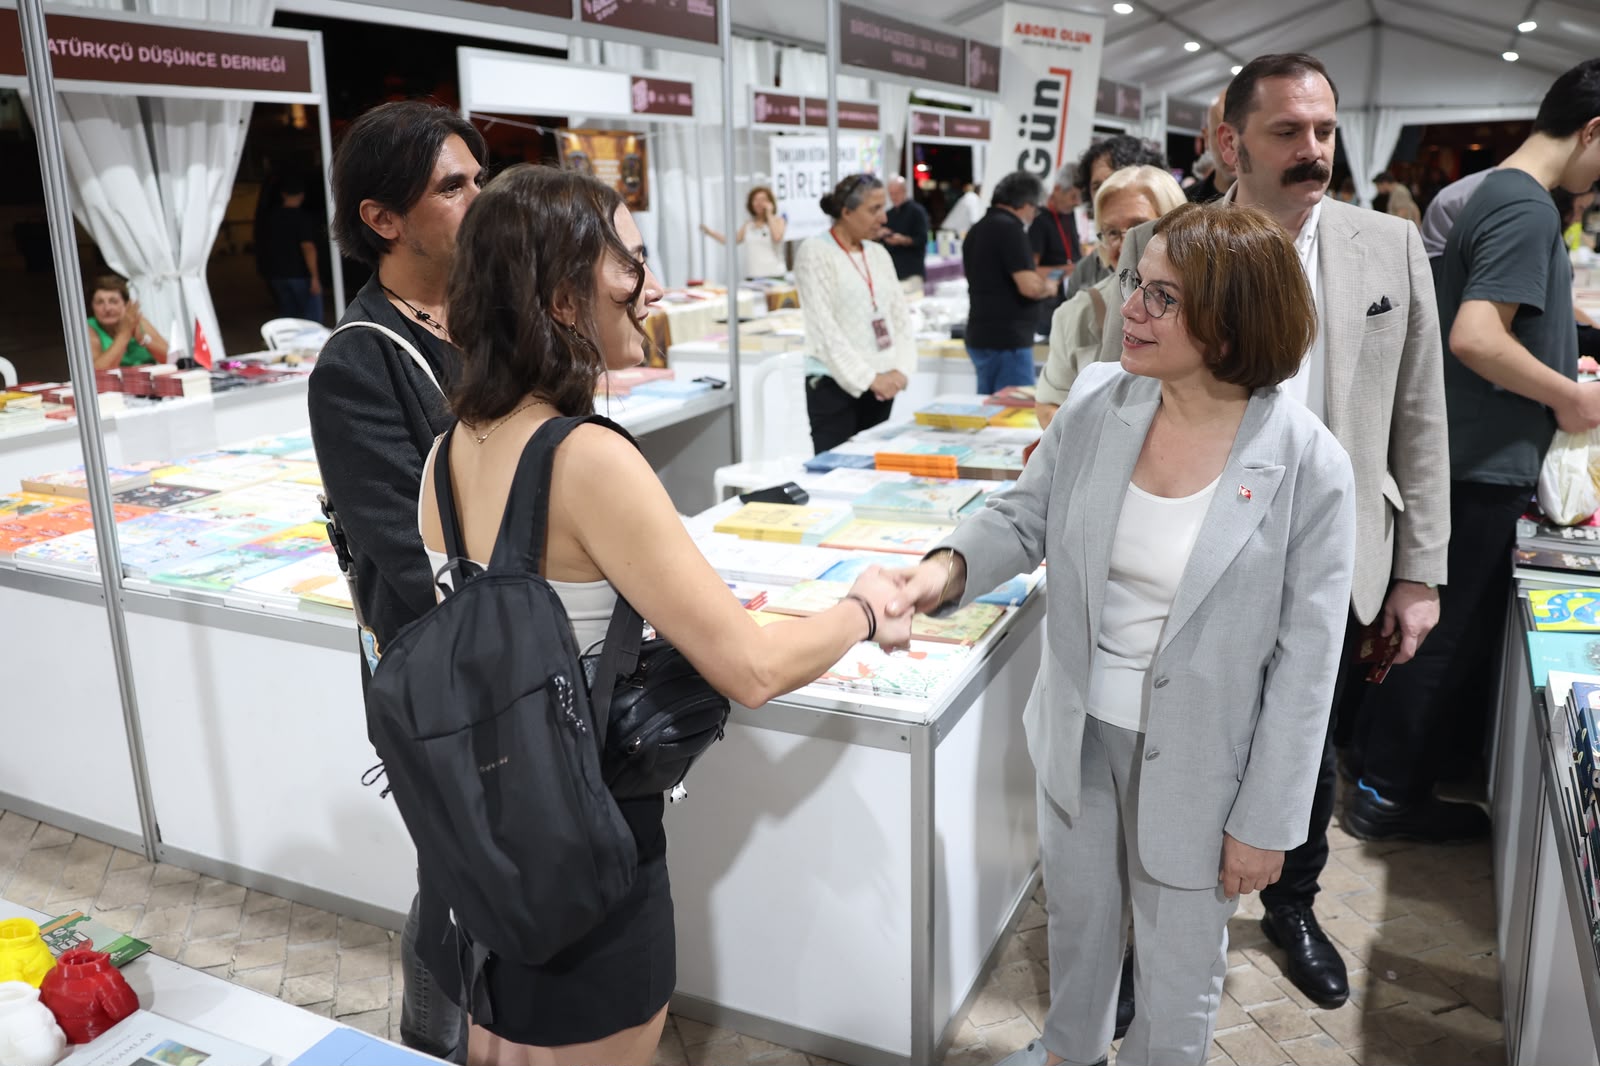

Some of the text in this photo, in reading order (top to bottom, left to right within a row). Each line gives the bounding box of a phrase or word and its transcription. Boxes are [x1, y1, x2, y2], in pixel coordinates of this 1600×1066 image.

[1013, 22, 1092, 44] ABONE OLUN
[48, 37, 287, 73] ATÜRKÇÜ DÜŞÜNCE DERNEĞİ
